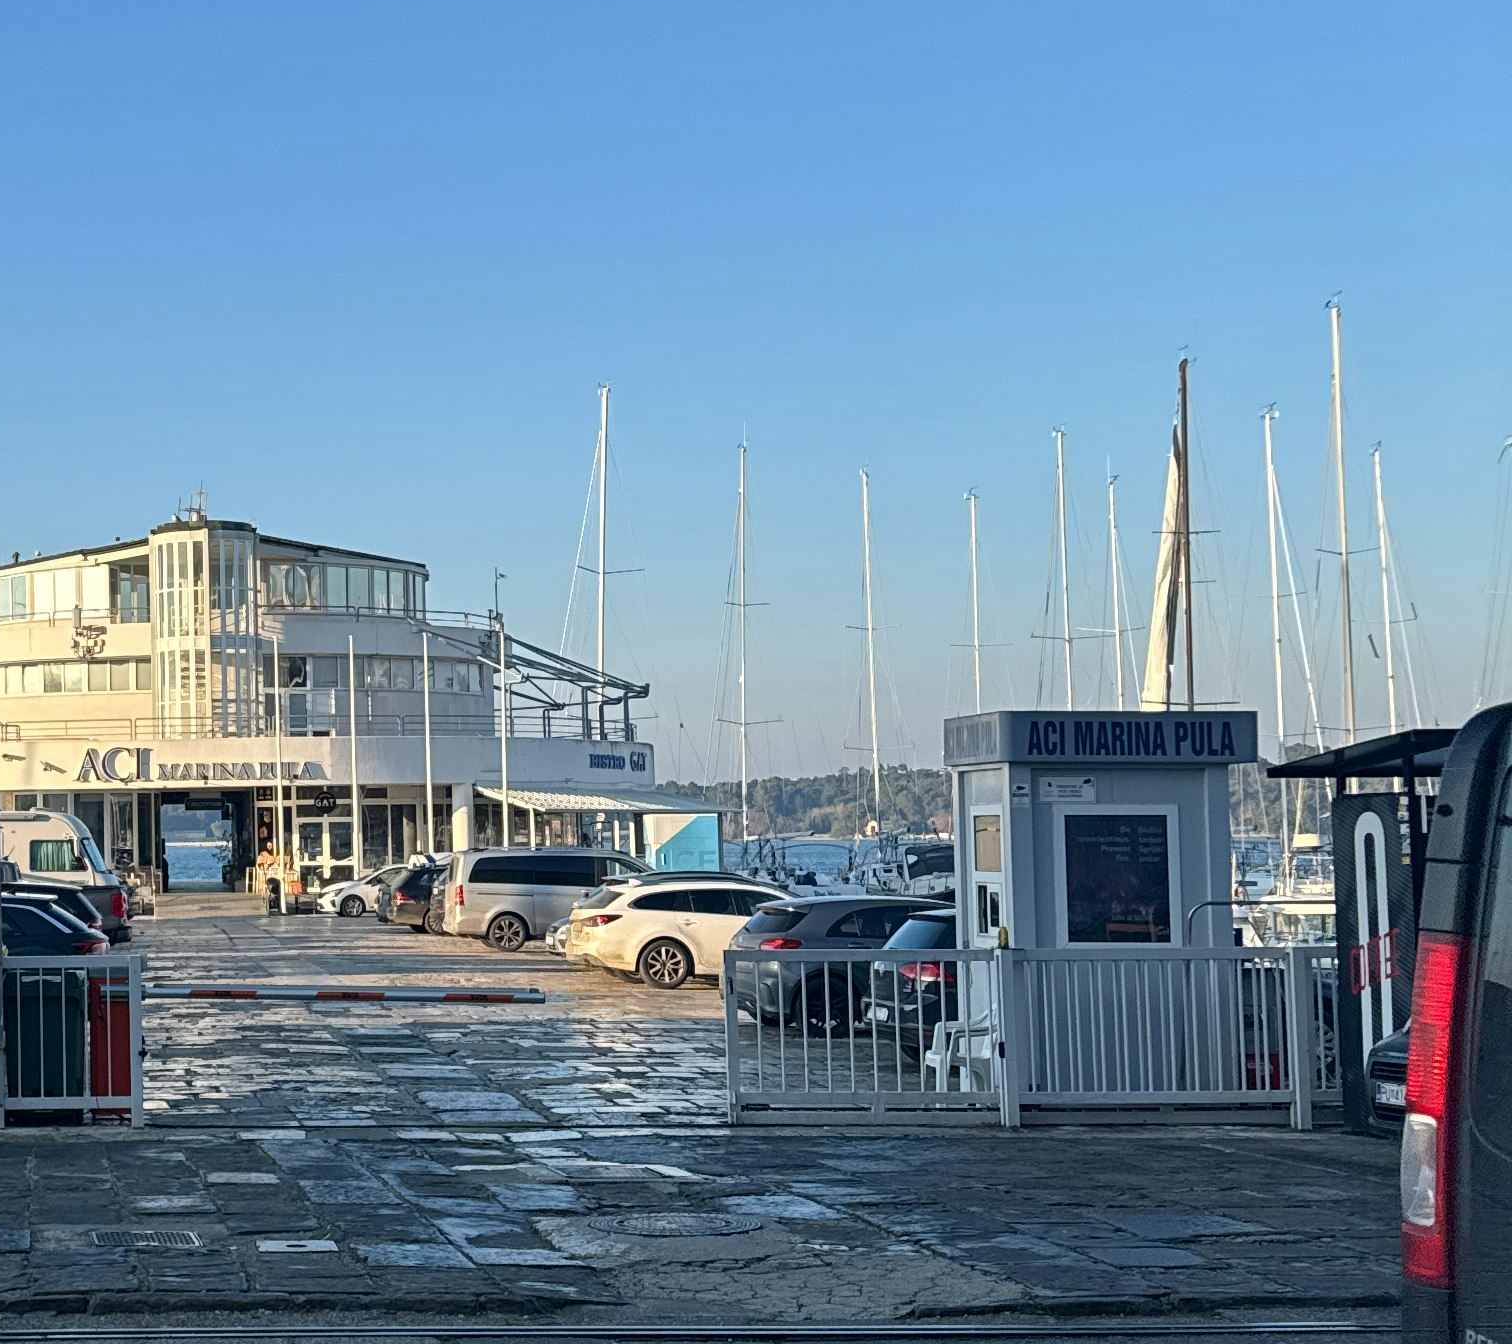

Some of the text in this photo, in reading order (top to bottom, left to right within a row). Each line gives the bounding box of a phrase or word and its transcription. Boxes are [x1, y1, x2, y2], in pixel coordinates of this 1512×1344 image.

[1027, 721, 1236, 757] ACI MARINA PULA
[75, 747, 317, 782] ACI MARINA PULA
[589, 751, 647, 772] BISTRO GAT
[315, 798, 335, 808] GAT
